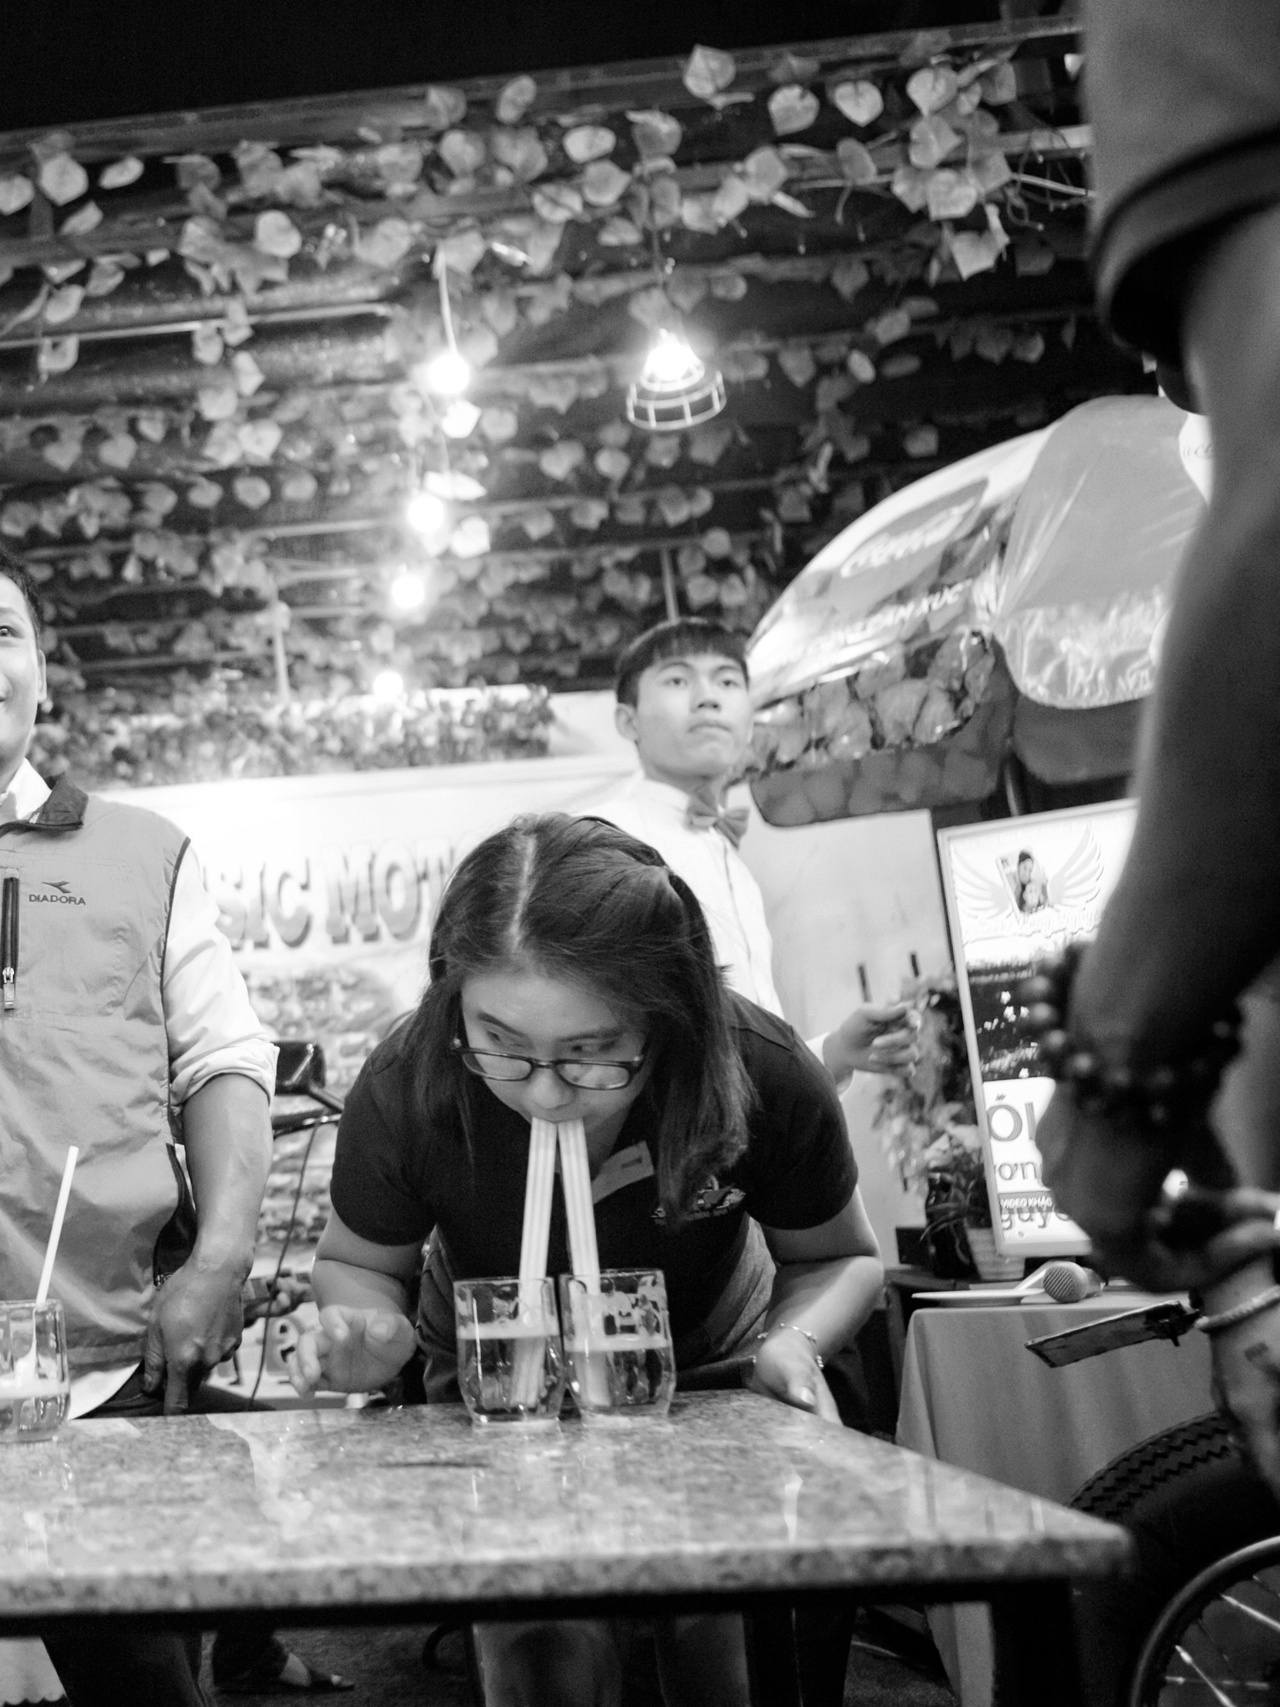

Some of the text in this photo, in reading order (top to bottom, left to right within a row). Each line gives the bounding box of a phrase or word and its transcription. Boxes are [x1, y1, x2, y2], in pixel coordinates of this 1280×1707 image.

[28, 893, 87, 906] DIADORA
[204, 837, 462, 951] SIC MOT
